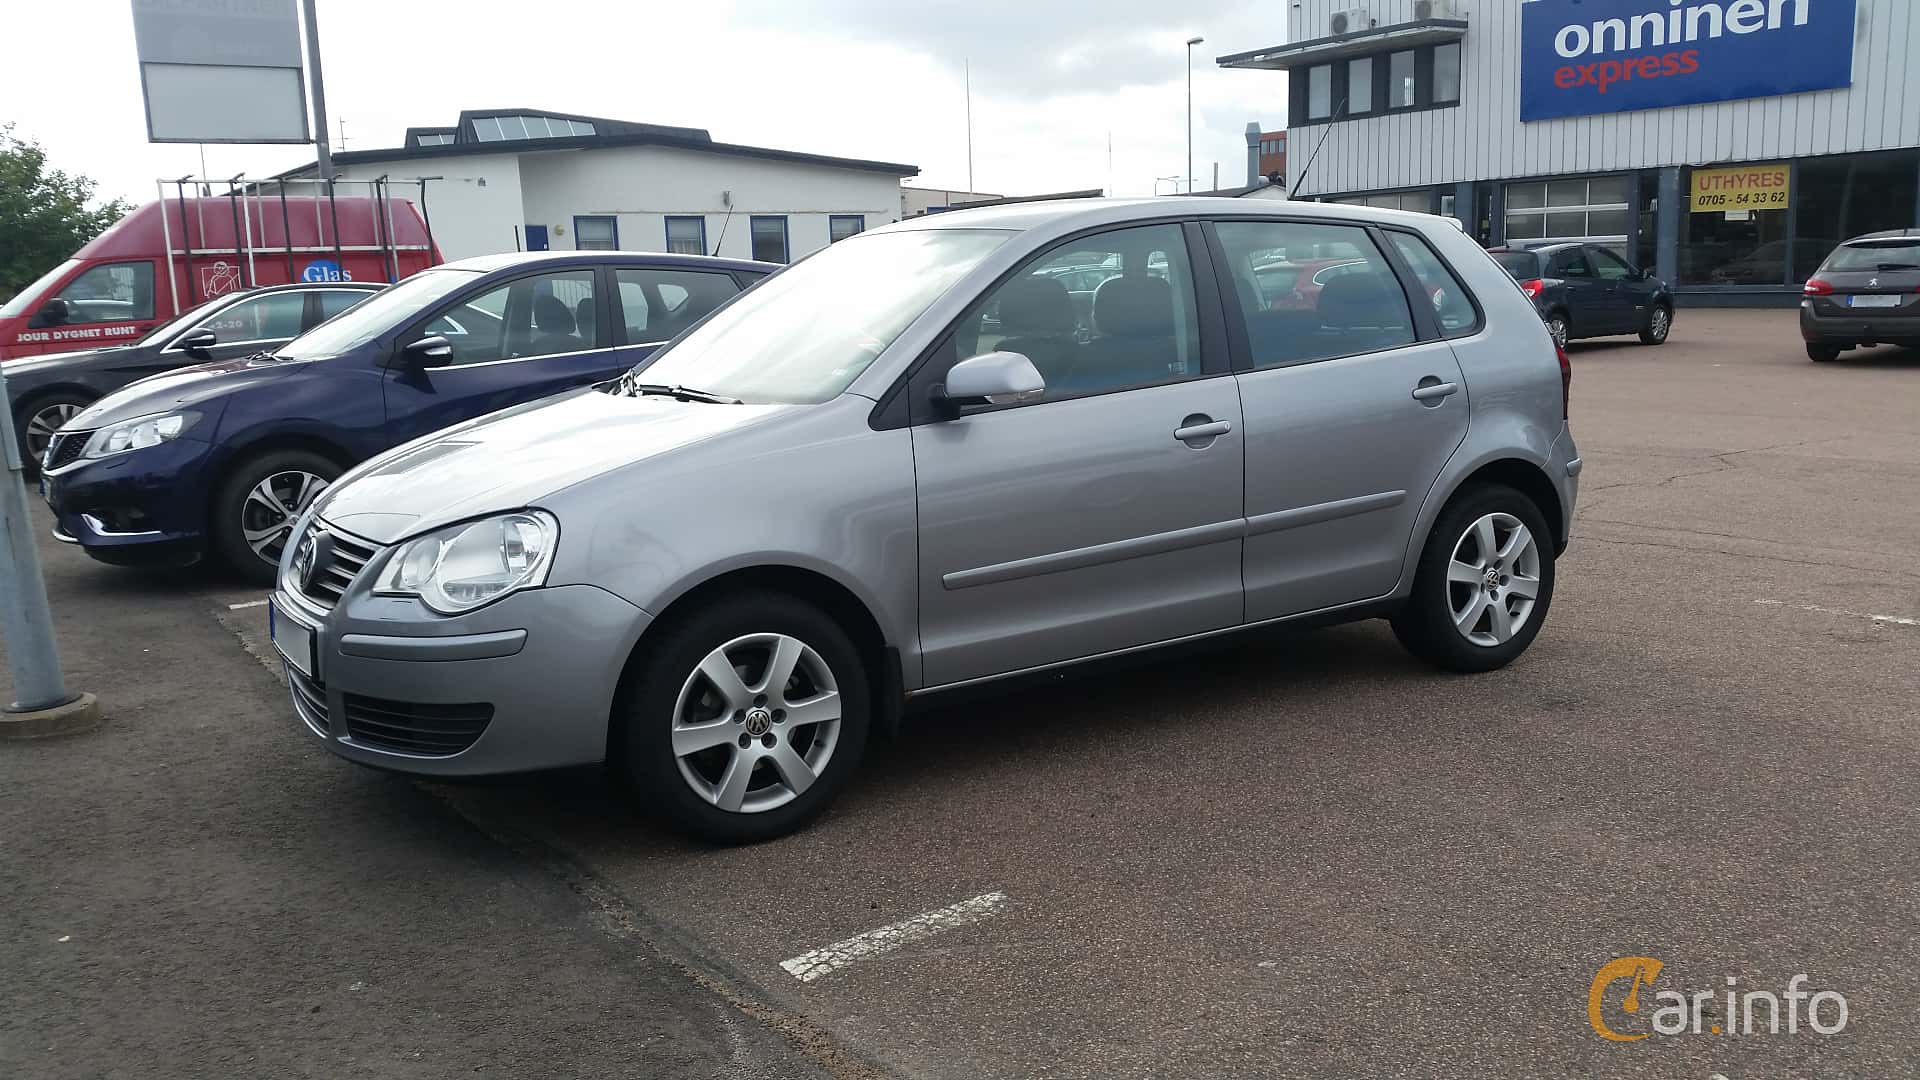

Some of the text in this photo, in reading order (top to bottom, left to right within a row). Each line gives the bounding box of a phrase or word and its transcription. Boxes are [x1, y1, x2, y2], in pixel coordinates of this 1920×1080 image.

[1554, 0, 1809, 58] onninen
[1554, 50, 1699, 94] express
[1700, 172, 1785, 191] UTHYRES
[1698, 195, 1726, 206] 0705
[1736, 193, 1750, 204] 54
[1752, 192, 1767, 203] 33
[1770, 191, 1785, 202] 62
[303, 266, 353, 281] Glas
[17, 326, 136, 342] JOUR DYGNET RUNT
